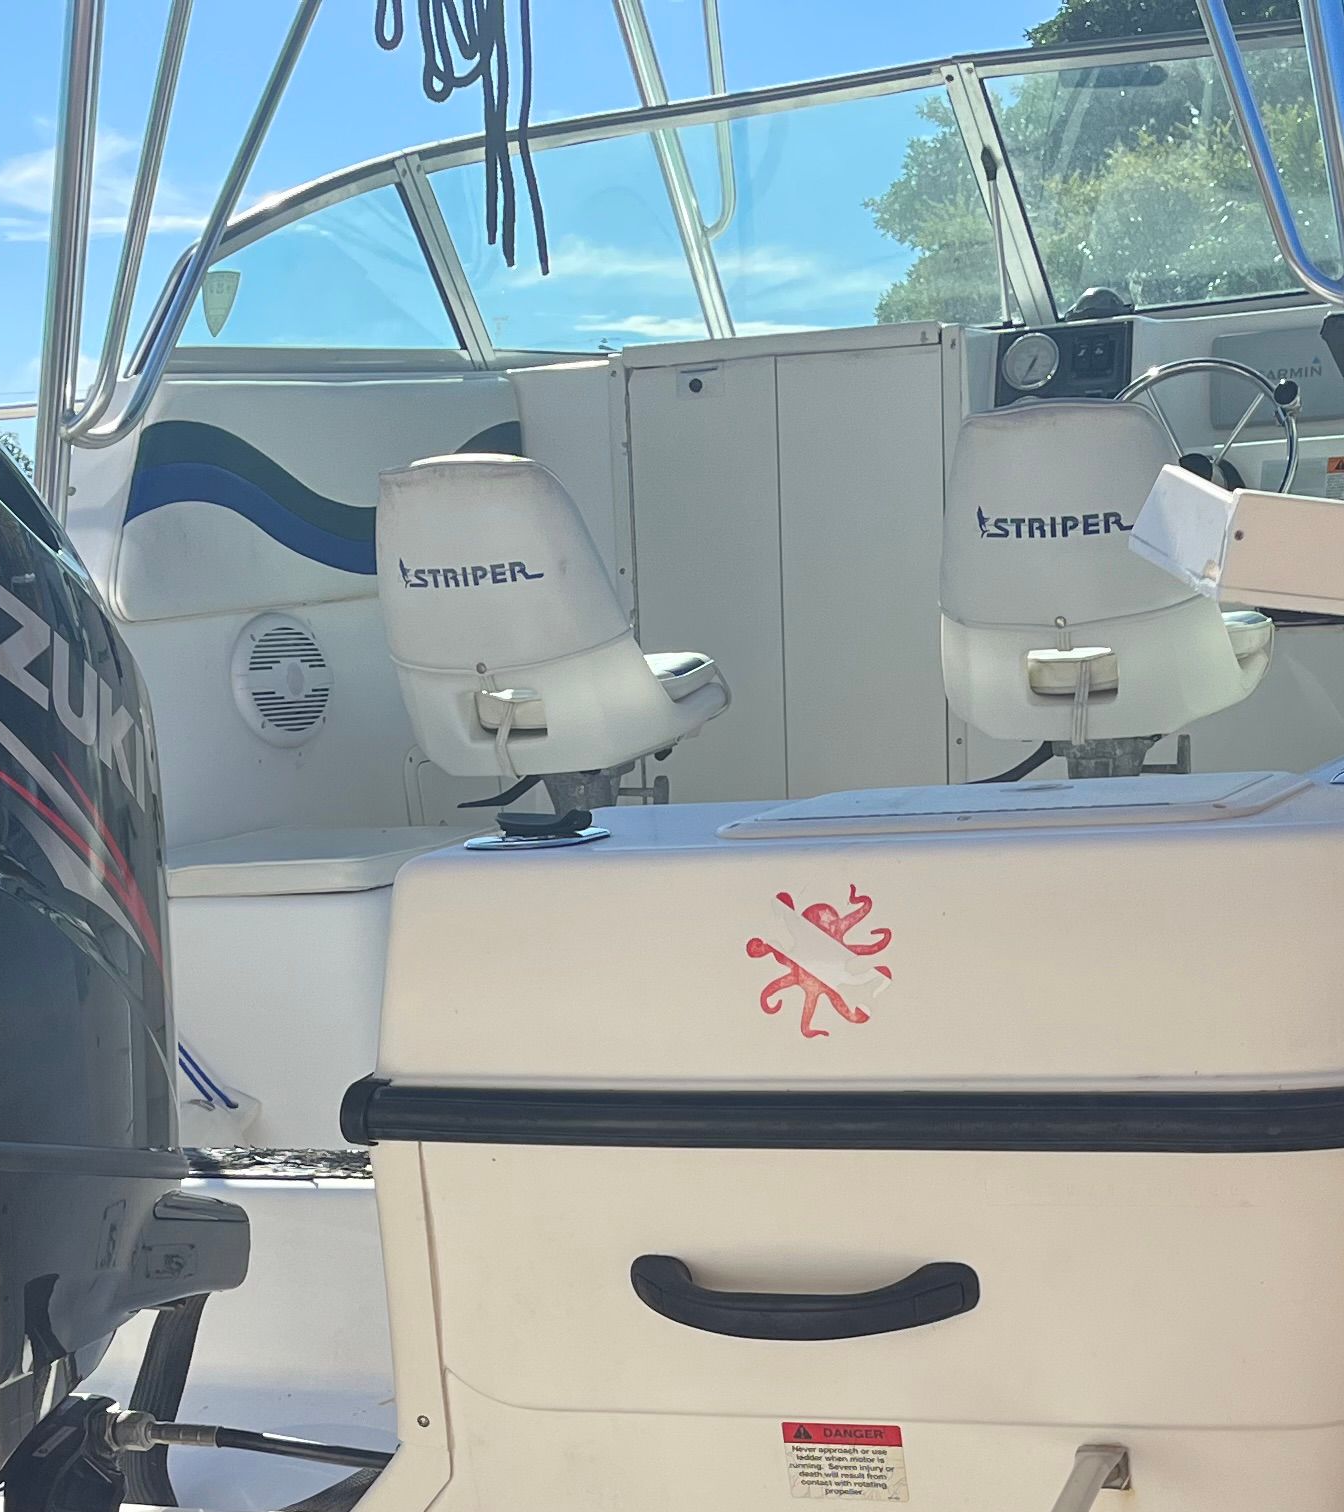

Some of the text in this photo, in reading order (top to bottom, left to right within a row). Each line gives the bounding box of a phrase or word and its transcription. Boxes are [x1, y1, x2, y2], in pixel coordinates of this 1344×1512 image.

[986, 512, 1134, 538] STRIPER
[409, 561, 545, 588] STRIPER
[823, 1427, 885, 1439] DANGER
[791, 1445, 817, 1453] Never
[818, 1447, 859, 1455] approach
[798, 1470, 823, 1478] death
[853, 1481, 888, 1490] rotating
